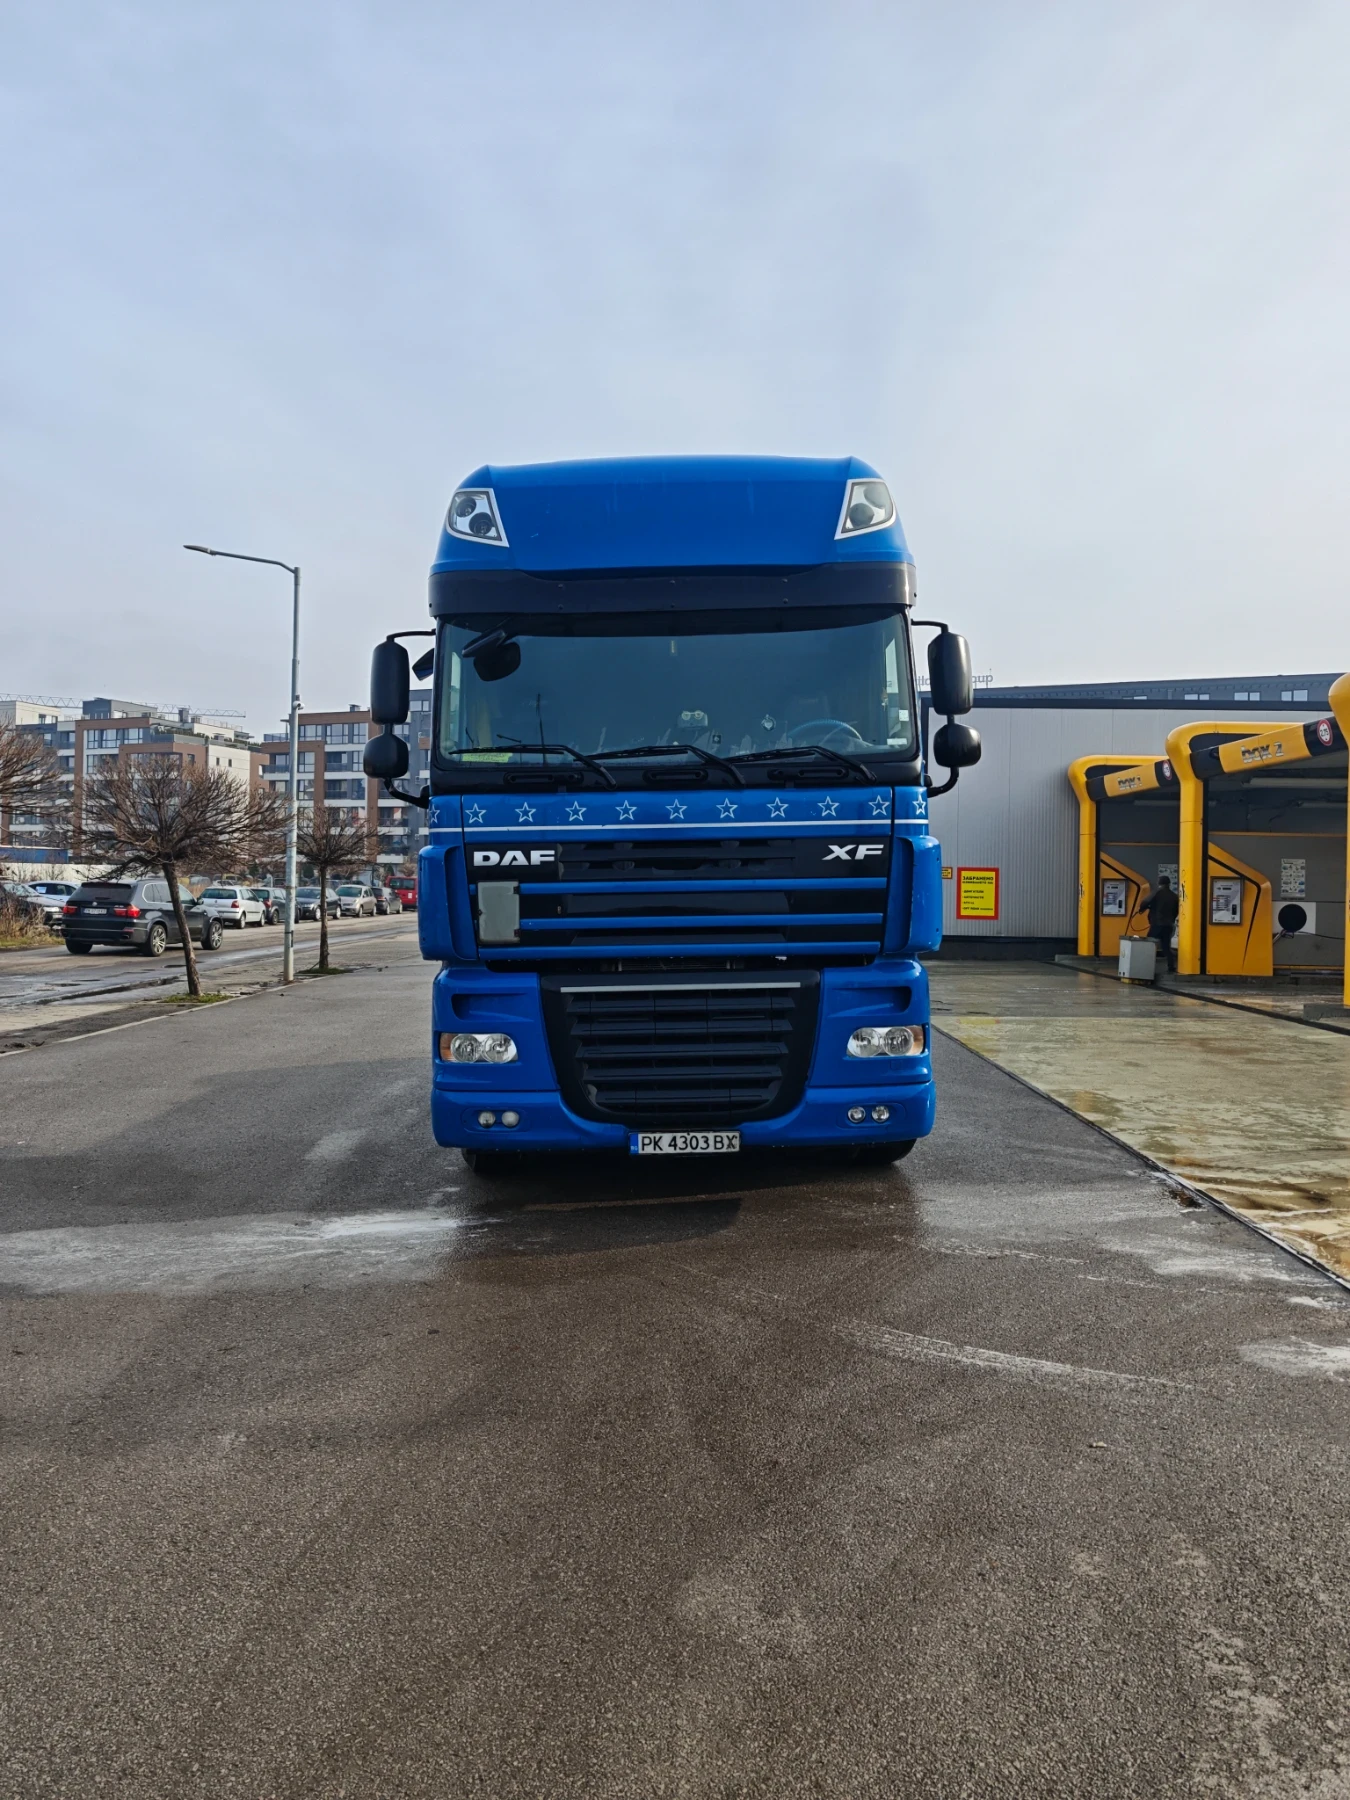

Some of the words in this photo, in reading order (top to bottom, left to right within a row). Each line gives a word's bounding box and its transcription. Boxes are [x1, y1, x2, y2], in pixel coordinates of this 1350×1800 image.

[1273, 742, 1284, 757] 2
[473, 850, 555, 867] DAF
[821, 844, 884, 860] XF
[641, 1136, 663, 1151] PK
[668, 1135, 710, 1151] 4303
